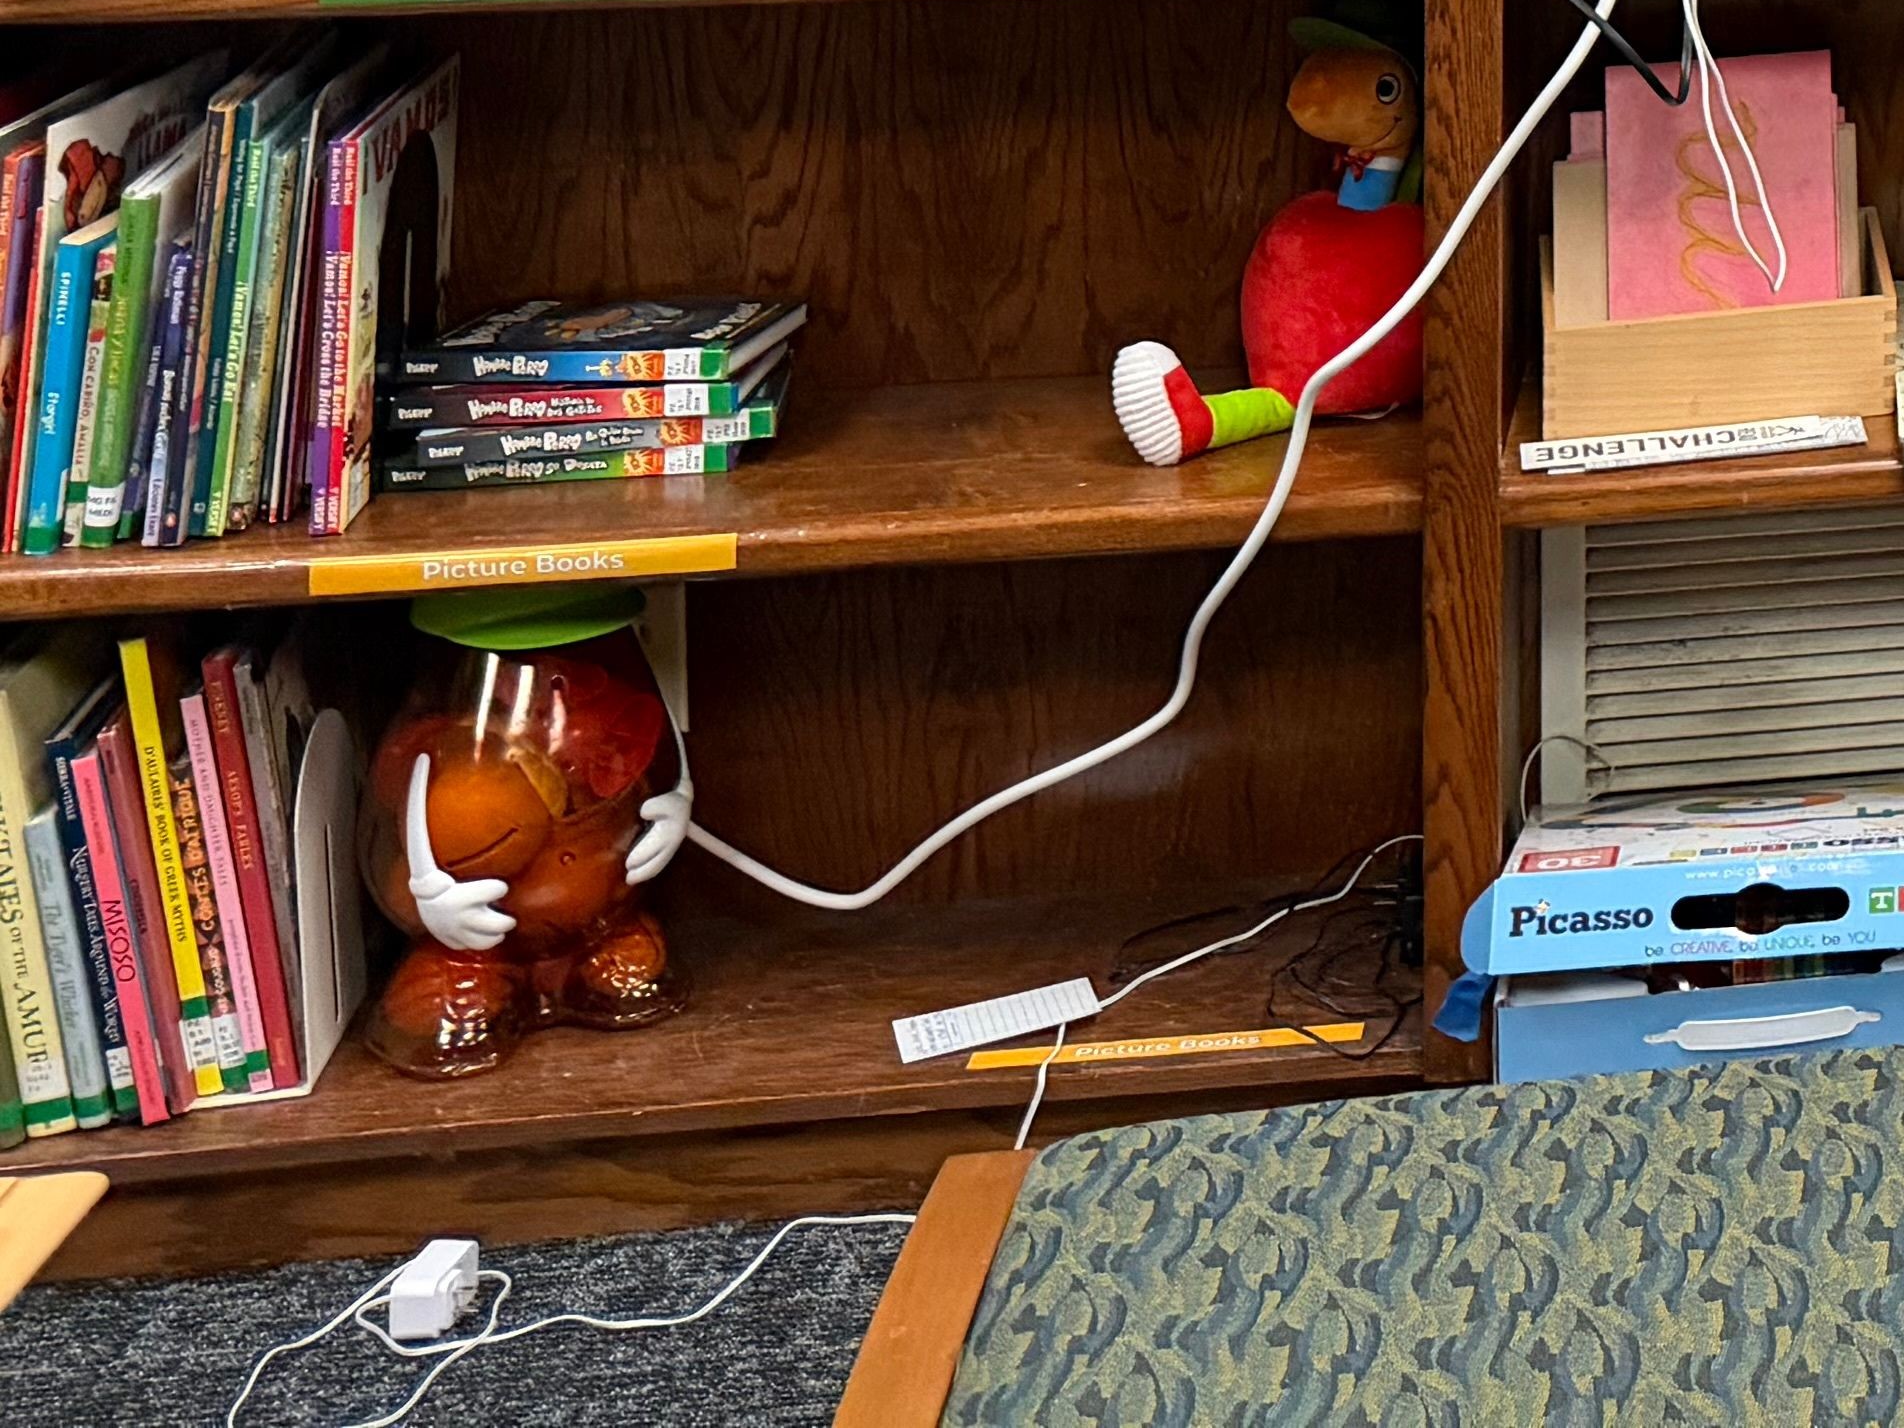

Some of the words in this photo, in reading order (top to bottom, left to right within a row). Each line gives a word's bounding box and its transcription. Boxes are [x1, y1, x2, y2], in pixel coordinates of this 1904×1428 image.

[1536, 430, 1735, 462] CHALLENGE
[421, 554, 529, 582] Picture
[536, 549, 625, 575] Books
[1509, 902, 1654, 938] Picasso
